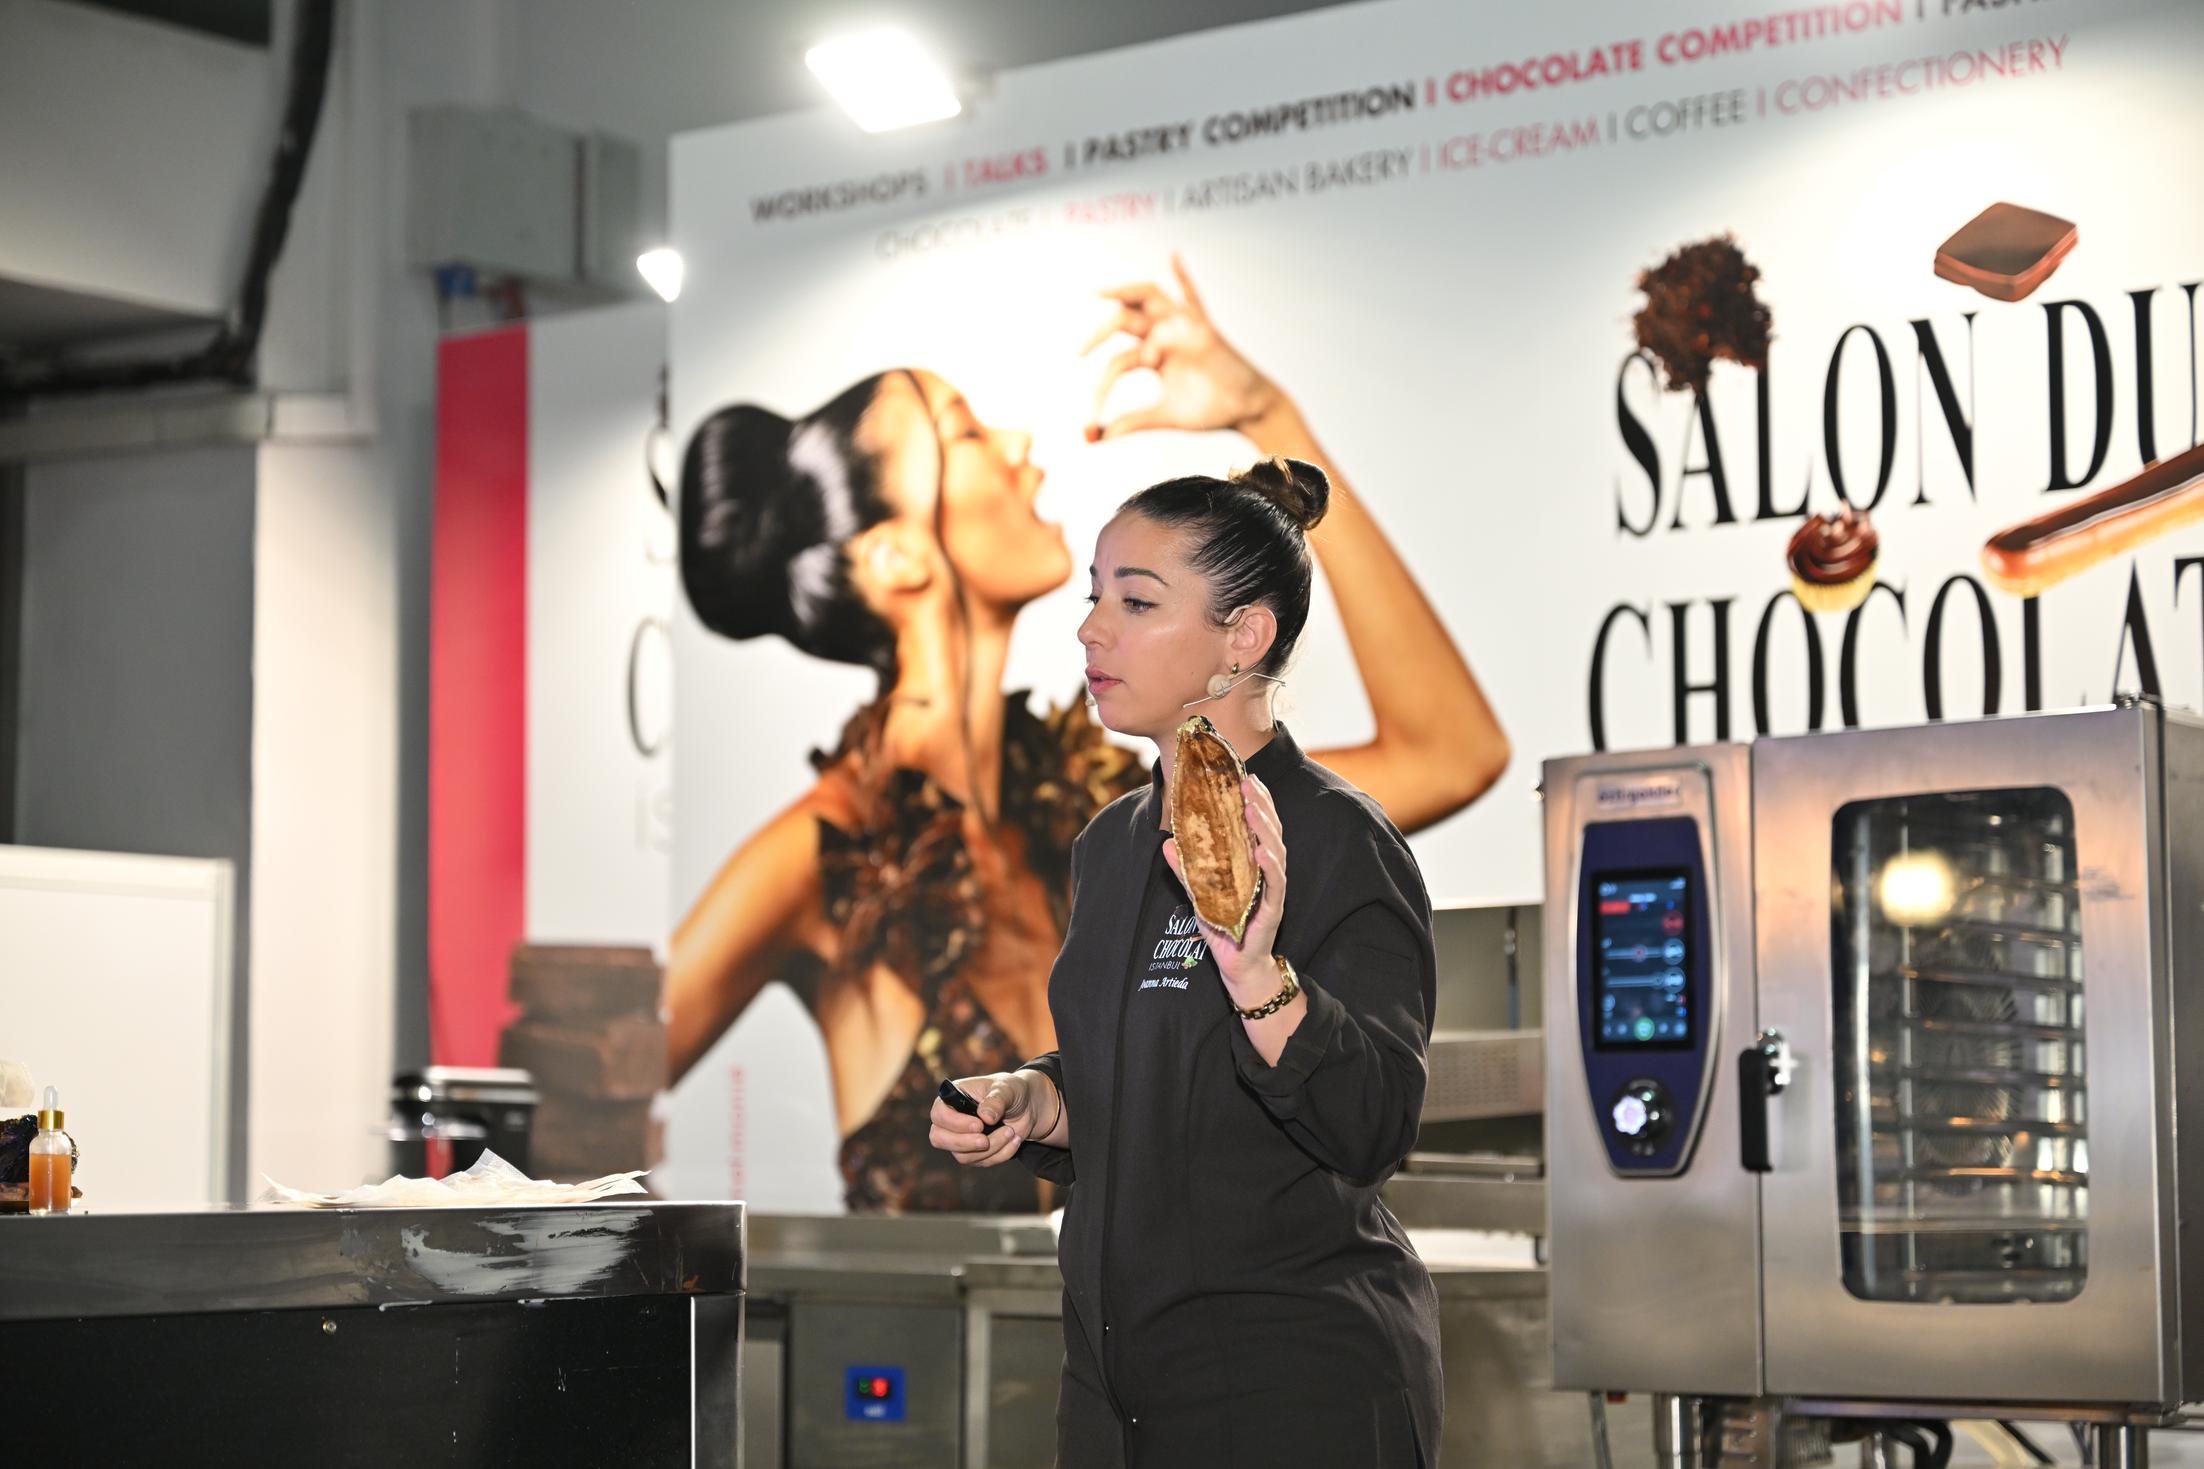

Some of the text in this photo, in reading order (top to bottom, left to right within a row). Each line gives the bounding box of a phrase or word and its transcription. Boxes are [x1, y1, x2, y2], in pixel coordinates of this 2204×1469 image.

[750, 167, 928, 221] WORKSHOPS
[963, 145, 1048, 186] TALKS
[1083, 121, 1194, 163] PASTRY
[1203, 80, 1415, 146] COMPETITION
[1446, 38, 1644, 103] CHOCOLATE
[1656, 0, 1903, 66] COMPETITION
[1180, 165, 1299, 208] ARTISAN
[1304, 147, 1412, 192] BAKERY
[1438, 116, 1599, 171] ICE-CREAM
[1624, 88, 1747, 141] COFFEE
[1774, 33, 2070, 117] CONFECTIONERY
[1614, 310, 1978, 540] SALON
